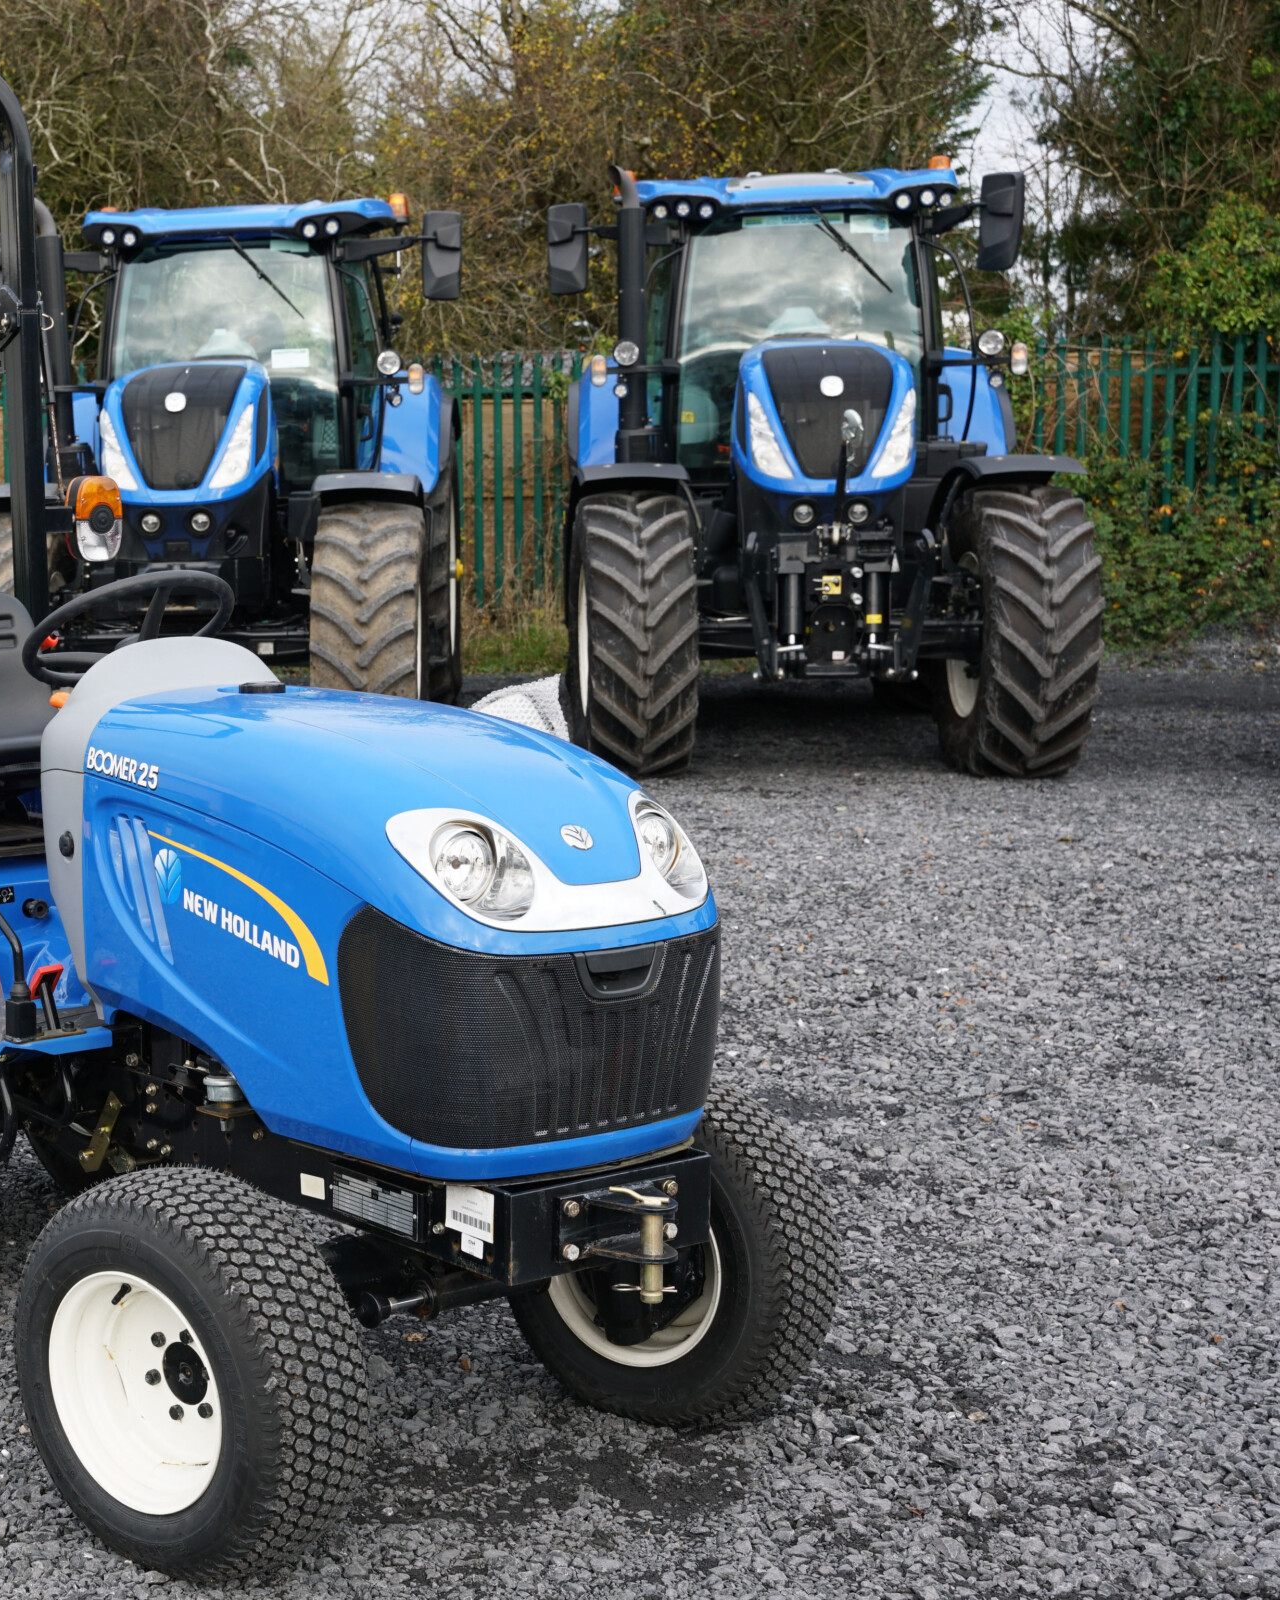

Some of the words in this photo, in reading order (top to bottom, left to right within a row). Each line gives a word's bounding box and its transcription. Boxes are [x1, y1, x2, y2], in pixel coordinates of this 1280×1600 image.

[86, 746, 137, 784] BOOMER
[137, 763, 160, 790] 25
[183, 888, 218, 925] NEW
[221, 907, 300, 969] HOLLAND
